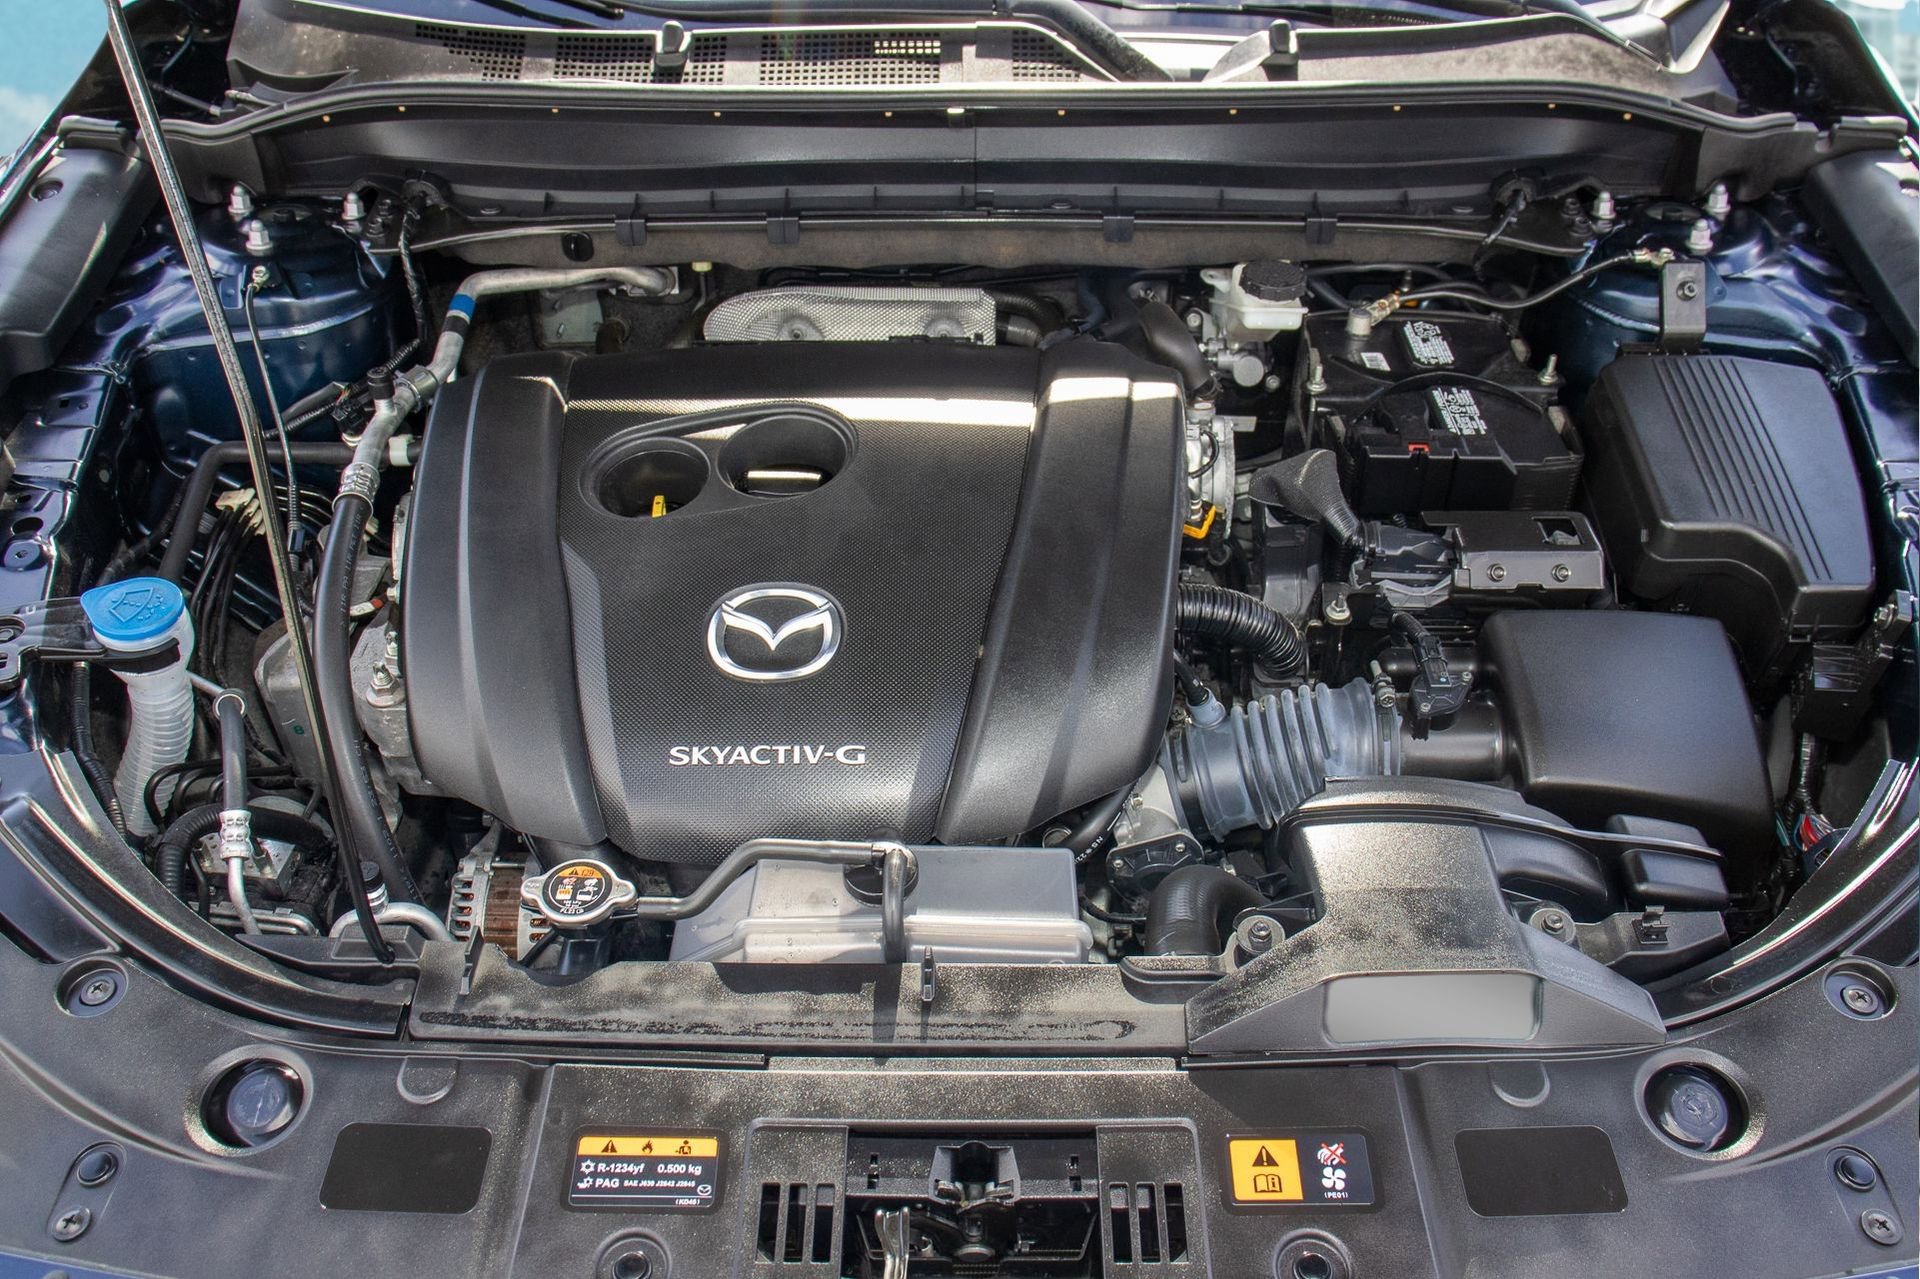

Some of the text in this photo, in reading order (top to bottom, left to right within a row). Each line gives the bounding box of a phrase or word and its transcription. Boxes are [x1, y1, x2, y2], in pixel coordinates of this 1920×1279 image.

[669, 745, 866, 765] SKYACTIV-G
[597, 1163, 702, 1175] R-1234yf 0.500 kg
[595, 1179, 620, 1188] PAG
